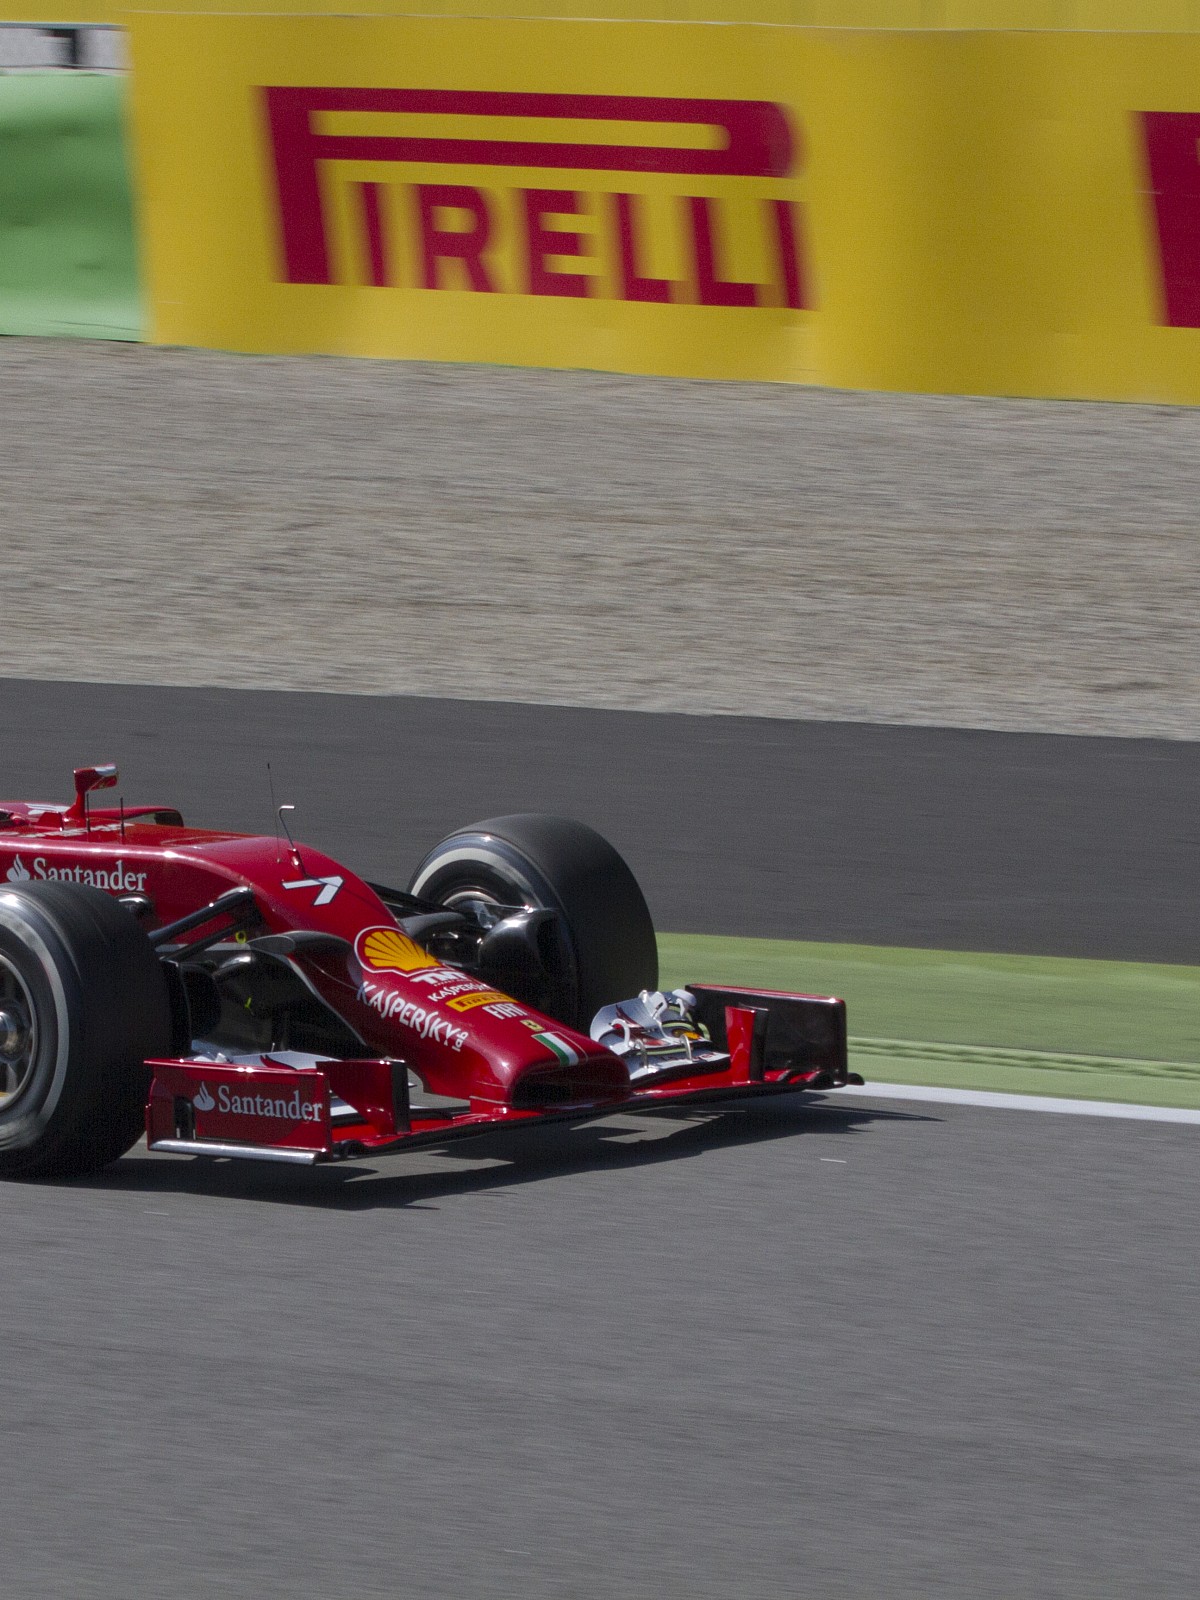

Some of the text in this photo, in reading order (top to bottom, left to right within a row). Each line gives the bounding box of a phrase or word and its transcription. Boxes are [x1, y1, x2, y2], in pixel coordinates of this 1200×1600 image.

[264, 85, 814, 310] PIRELLI
[33, 857, 147, 892] Santander
[280, 875, 345, 907] 7
[356, 980, 469, 1052] KASPERSKY lab
[482, 1003, 528, 1020] FIAT
[218, 1085, 323, 1122] Santander
